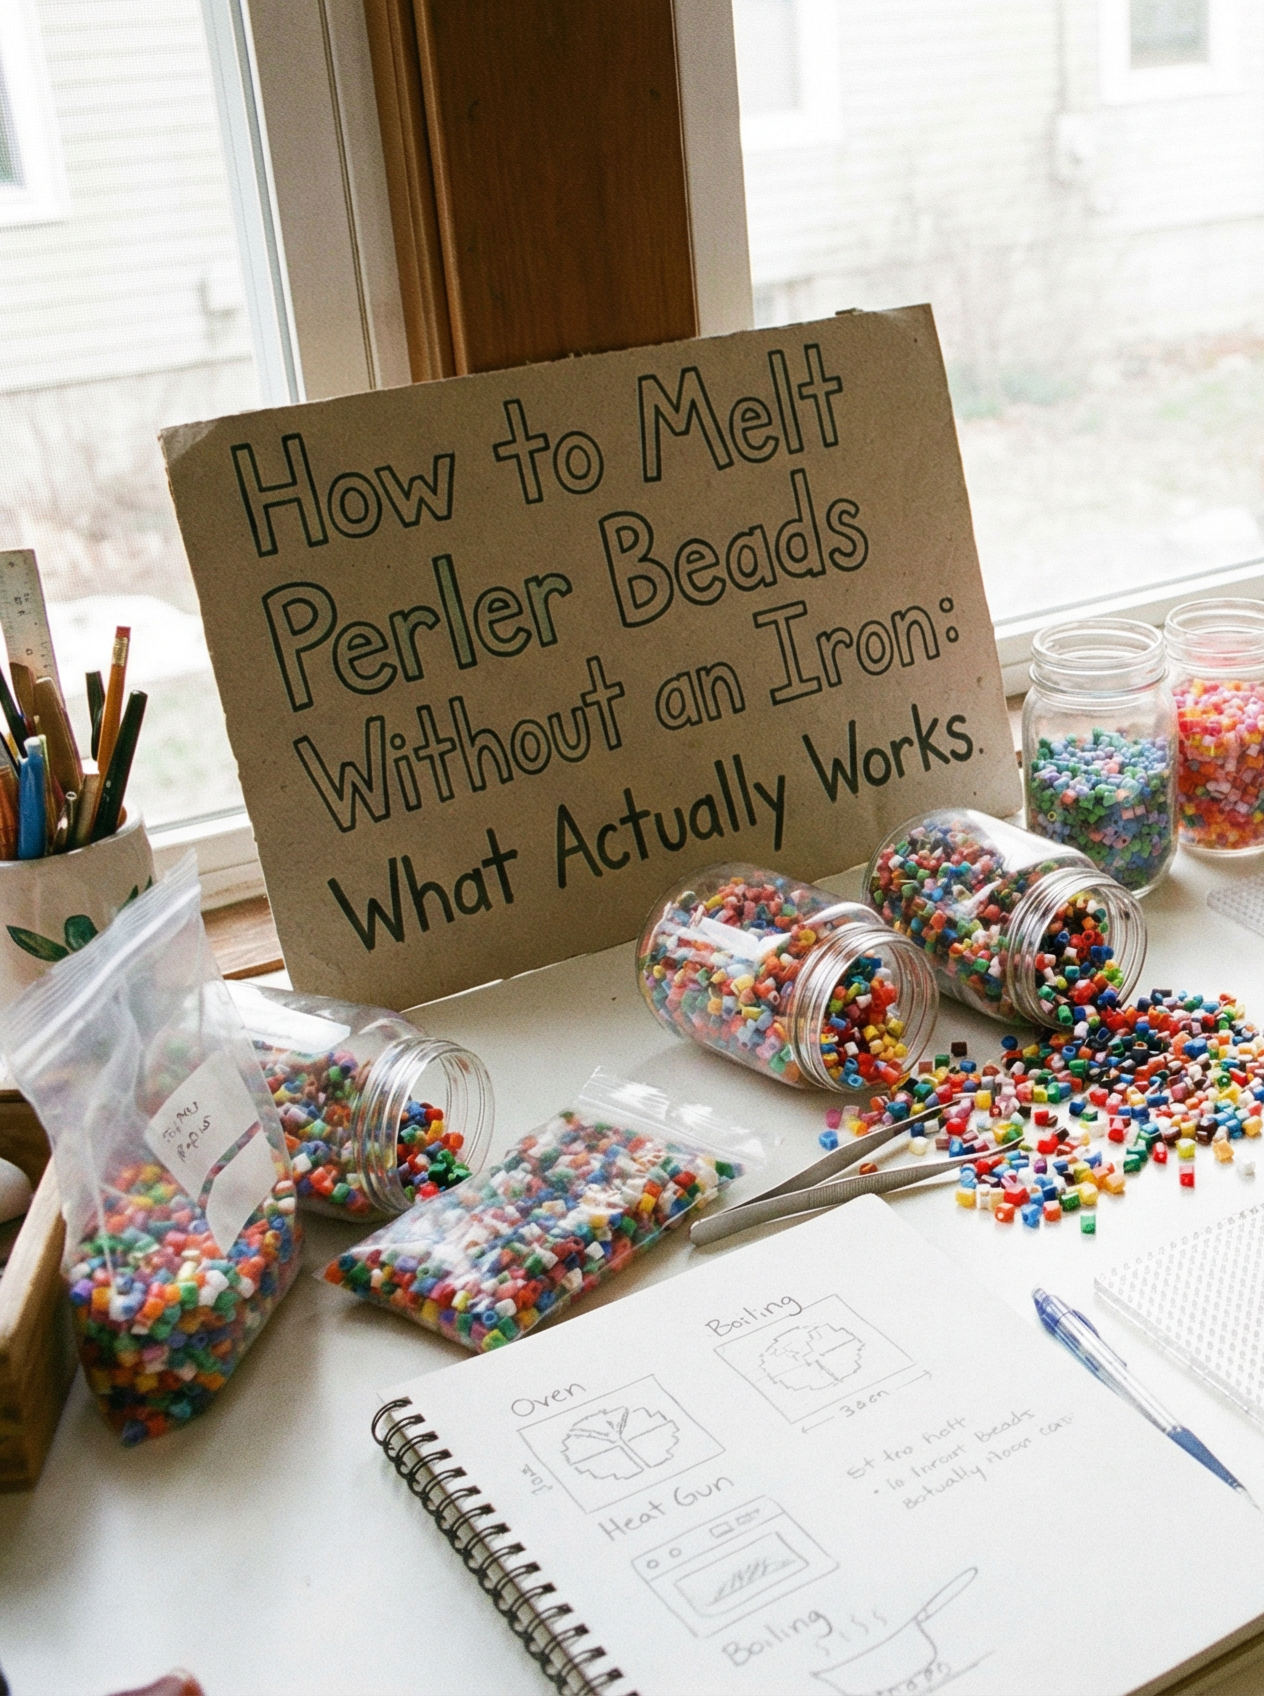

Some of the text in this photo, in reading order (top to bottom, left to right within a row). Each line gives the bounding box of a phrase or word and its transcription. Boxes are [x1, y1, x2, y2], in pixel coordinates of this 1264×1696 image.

[231, 344, 843, 557] How to Melt
[262, 469, 869, 711] Perler Beads
[294, 598, 960, 833] Without an Iron:
[328, 704, 984, 953] What Actually Works.
[705, 1296, 802, 1337] Boiling
[511, 1383, 586, 1417] Oven
[598, 1477, 734, 1541] Heat Gun
[721, 1610, 832, 1667] Boiling
